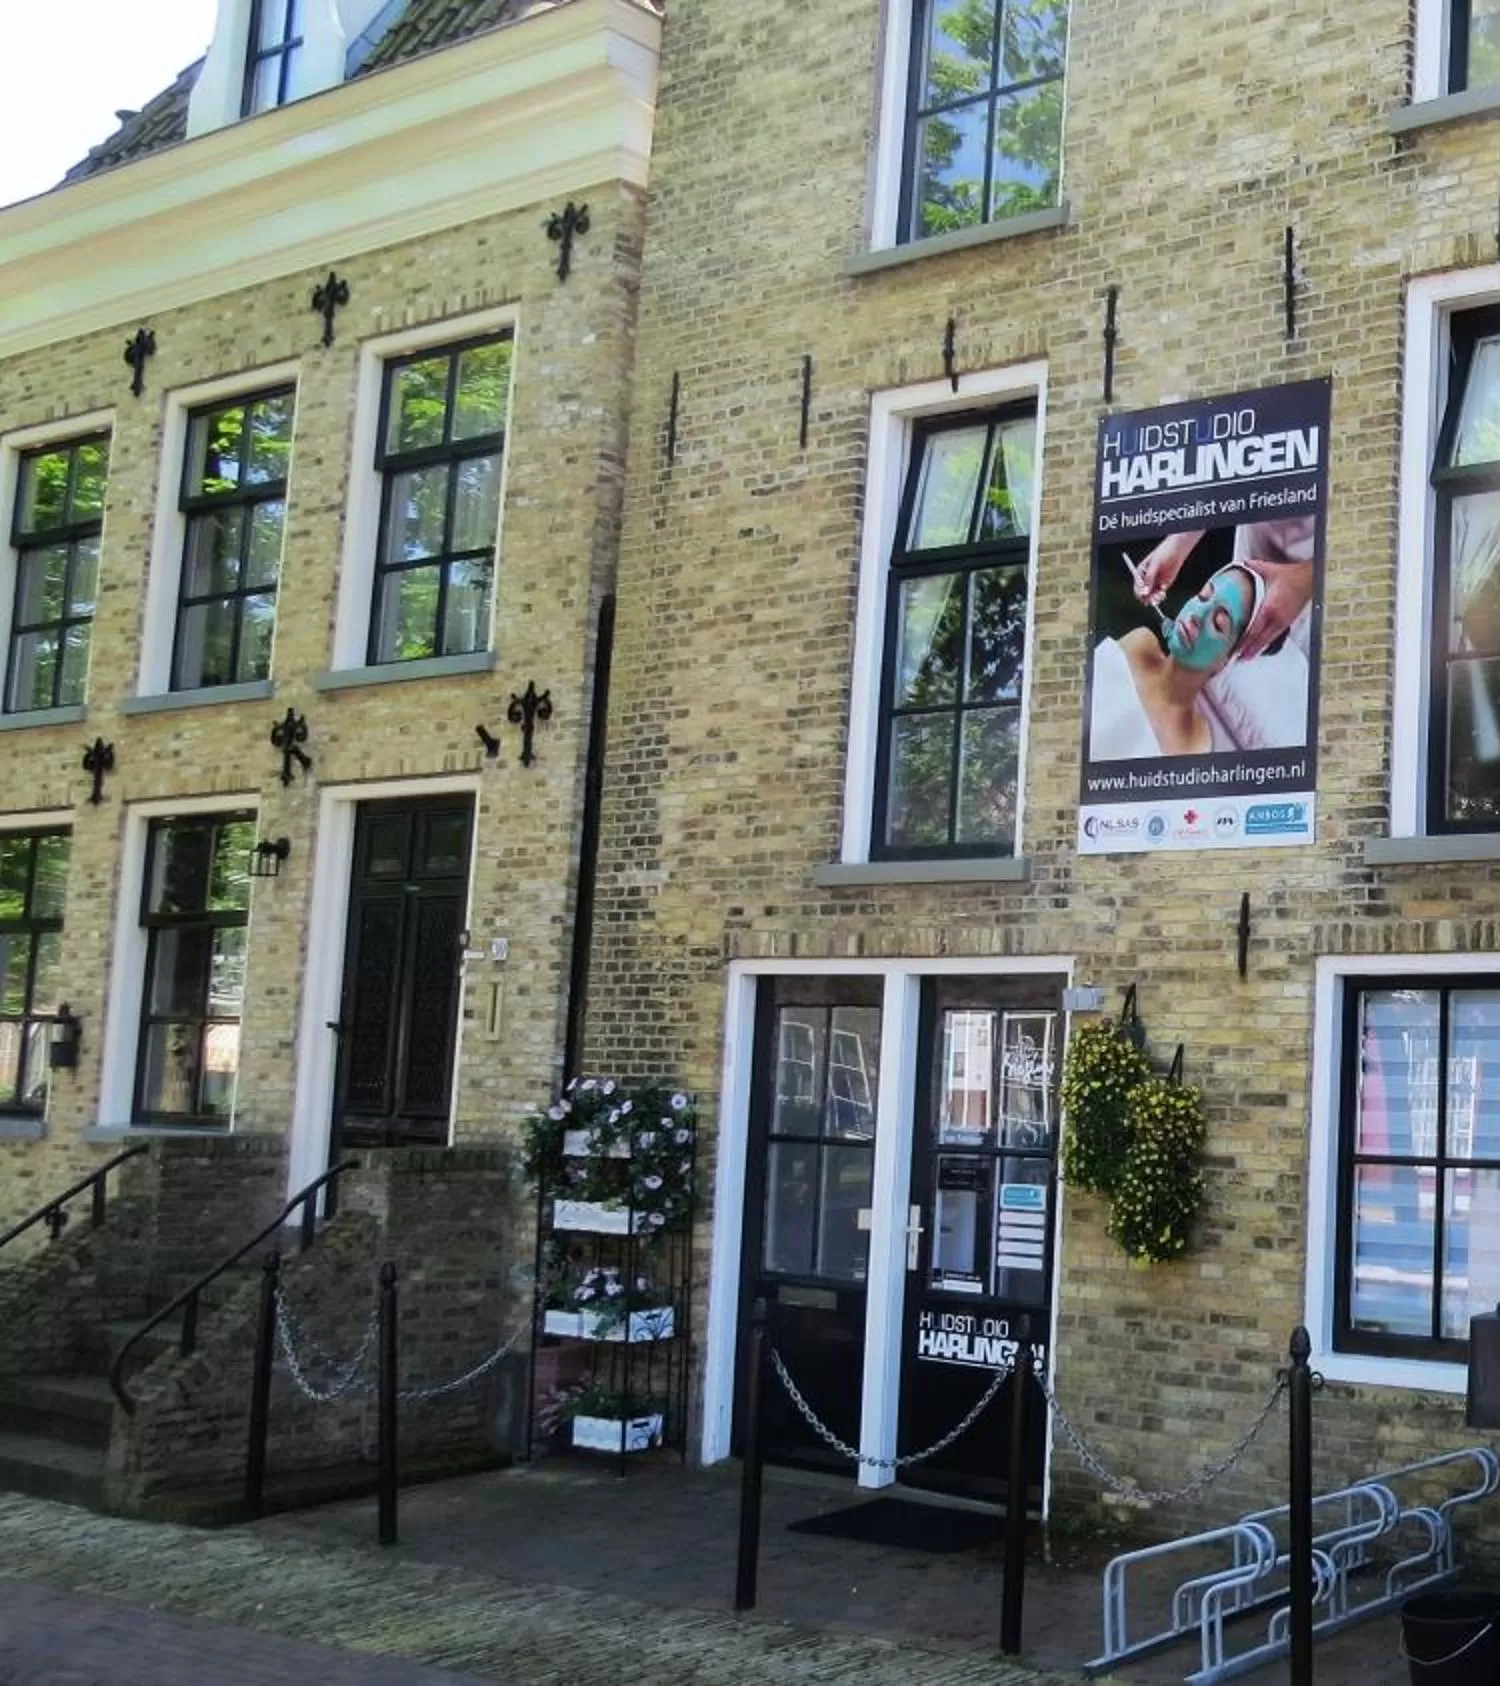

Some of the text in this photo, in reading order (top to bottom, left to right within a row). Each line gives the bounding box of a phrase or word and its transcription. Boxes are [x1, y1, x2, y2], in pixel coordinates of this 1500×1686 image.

[1101, 426, 1320, 498] HARLINGEN
[1121, 501, 1217, 528] huidspecialist
[1220, 497, 1246, 513] van
[1250, 484, 1317, 510] Friesland
[1087, 760, 1306, 792] www.huidstudioharlingen.nl
[918, 1329, 1045, 1369] HARLINGN
